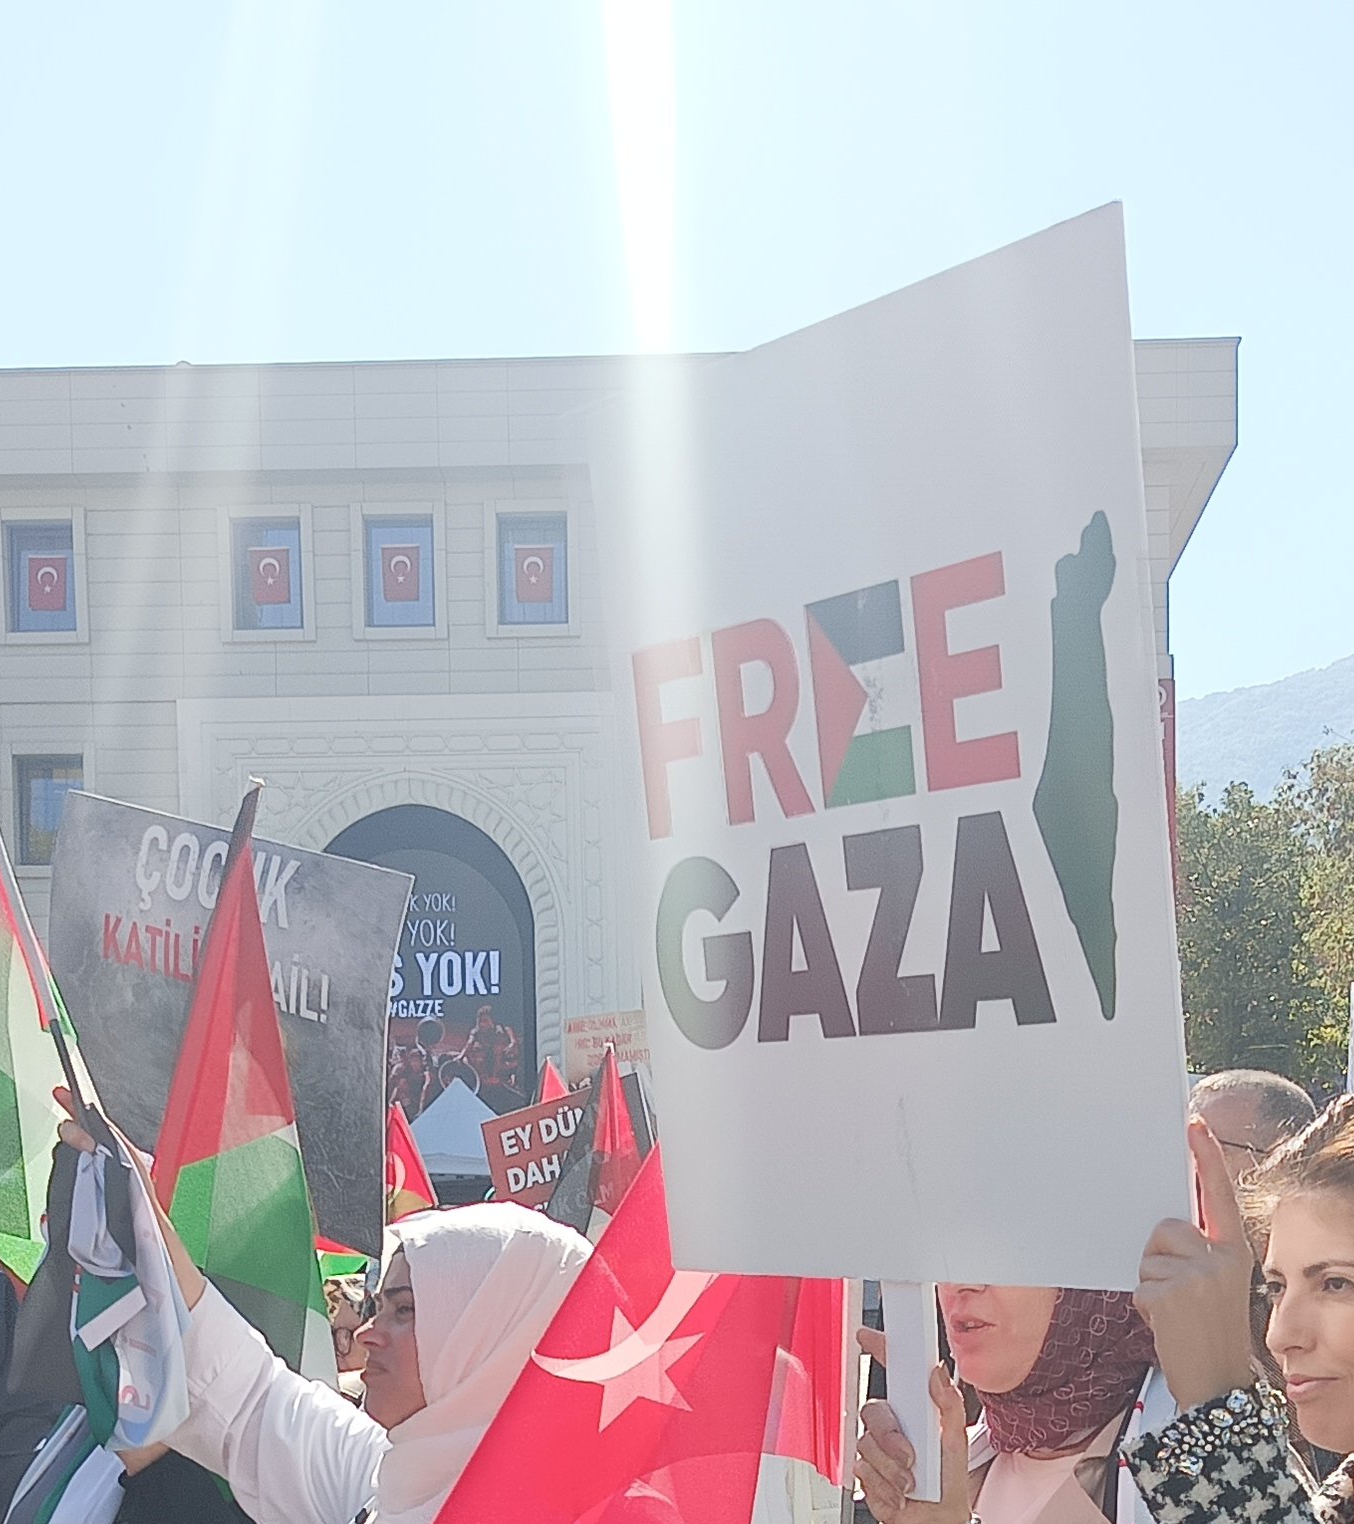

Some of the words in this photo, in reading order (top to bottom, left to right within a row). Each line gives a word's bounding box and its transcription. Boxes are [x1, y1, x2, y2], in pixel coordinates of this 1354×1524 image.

[632, 550, 1021, 841] FREE
[423, 893, 456, 912] YOK!
[406, 919, 455, 947] YOK!
[655, 811, 1057, 1050] GAZA
[415, 950, 500, 996] YOK!
[500, 1124, 532, 1156] EY
[506, 1150, 568, 1194] DAH
